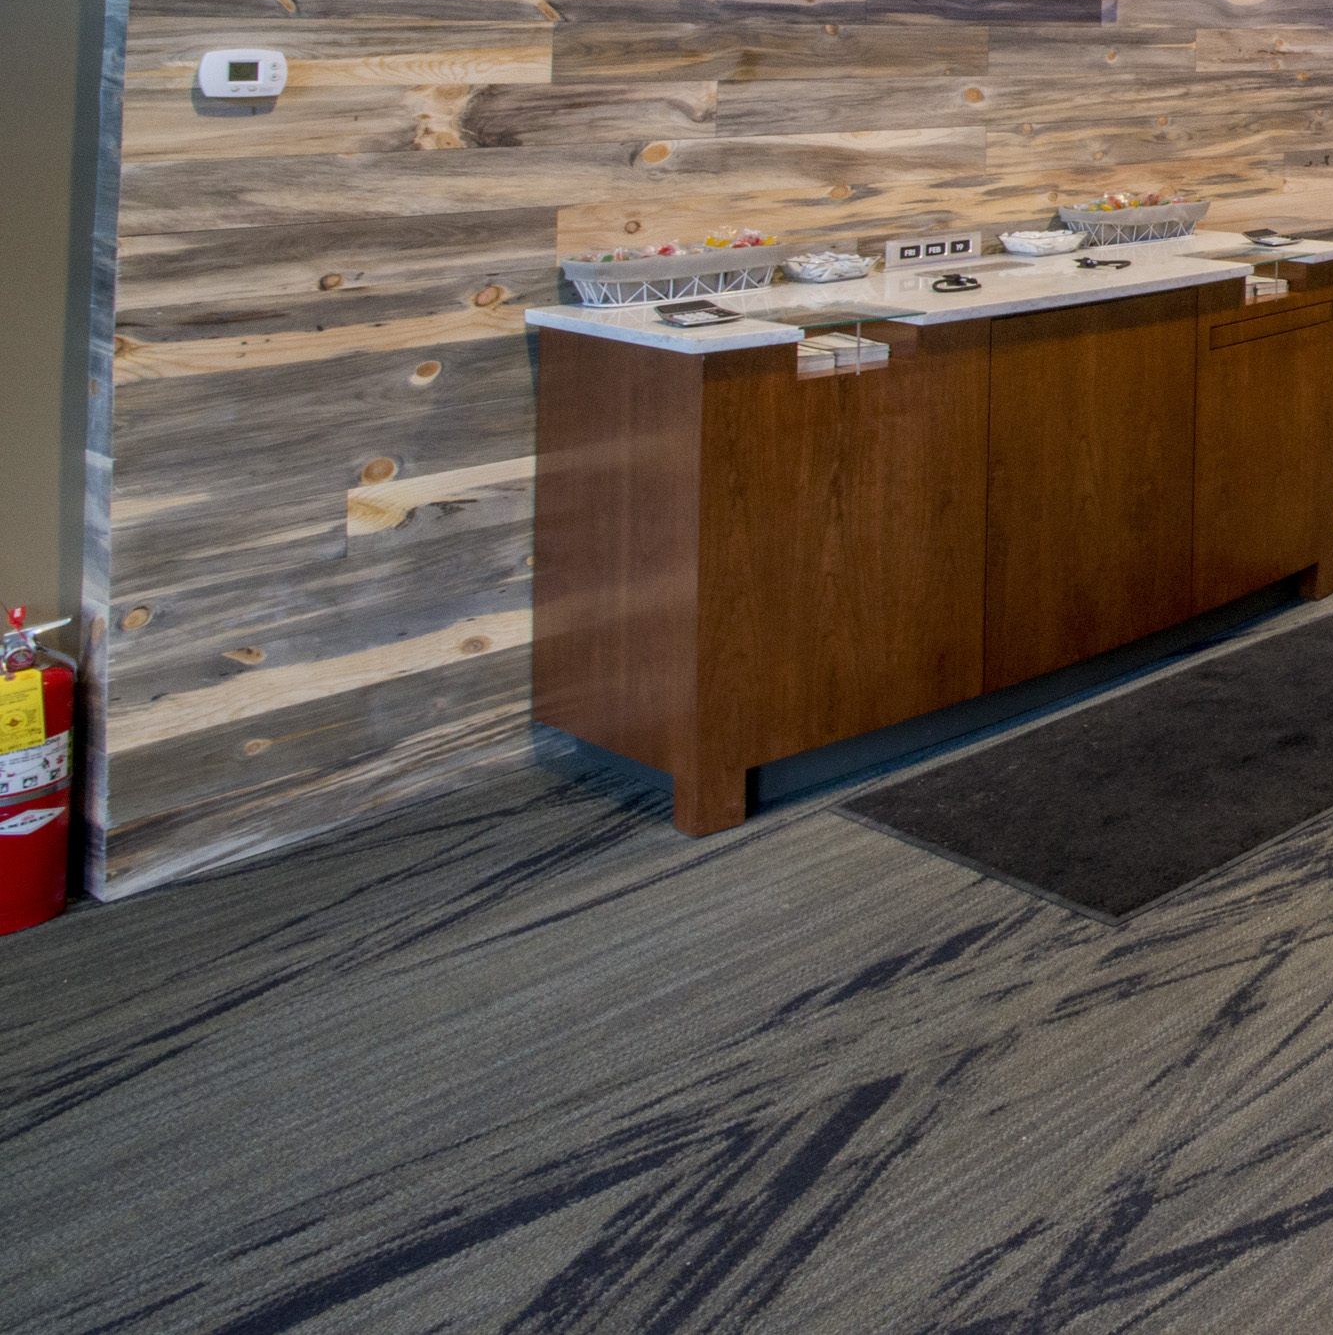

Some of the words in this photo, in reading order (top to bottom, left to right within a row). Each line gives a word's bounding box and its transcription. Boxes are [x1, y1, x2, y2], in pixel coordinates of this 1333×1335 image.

[904, 249, 916, 257] FRI
[928, 246, 941, 254] FEB
[956, 243, 964, 251] 19
